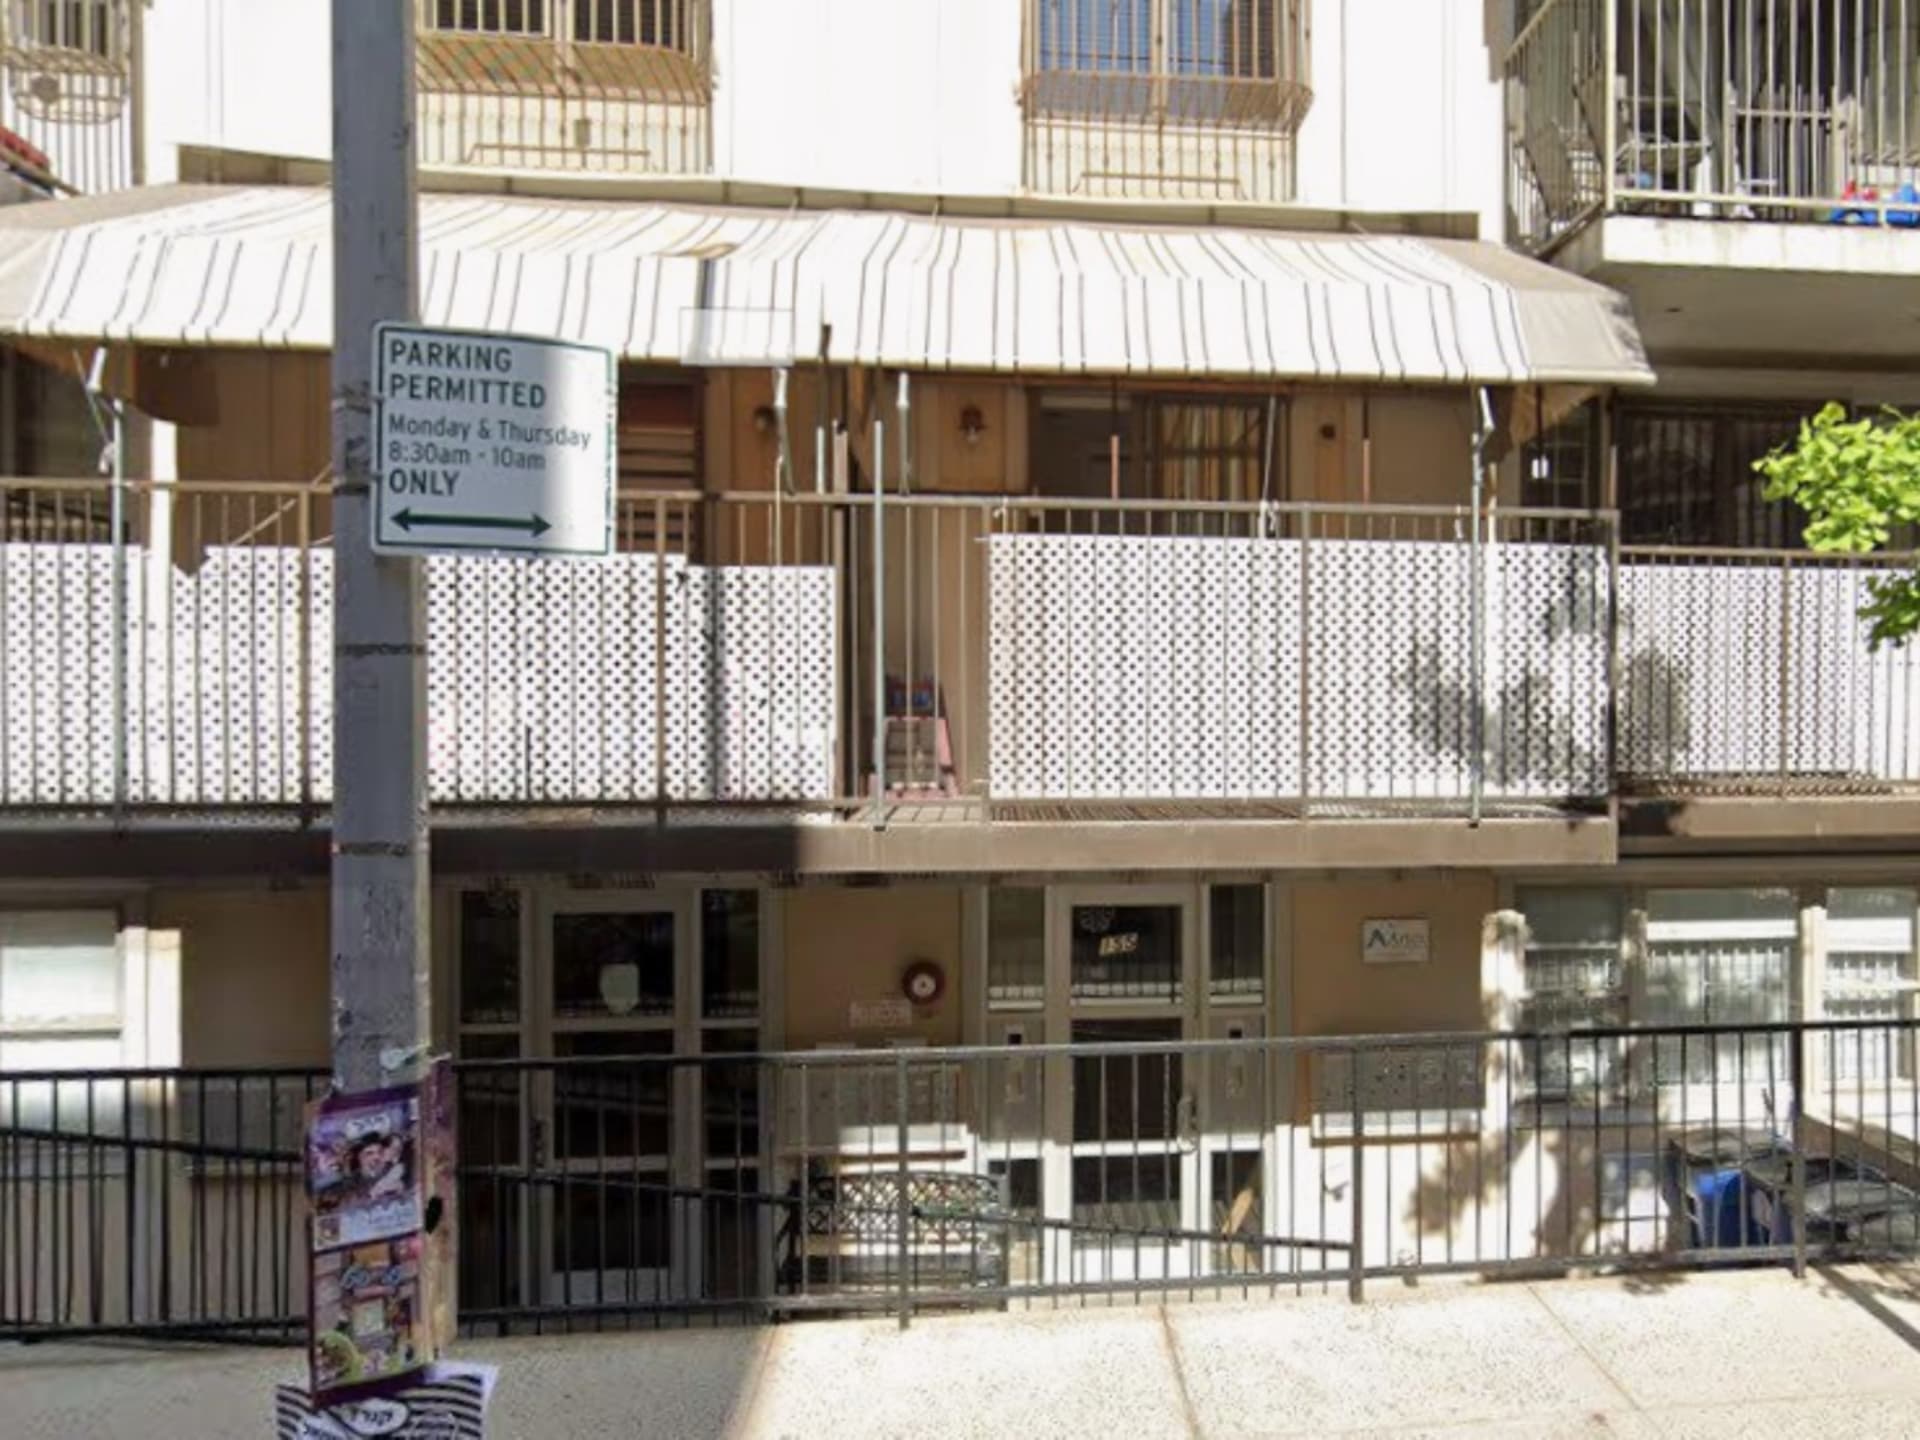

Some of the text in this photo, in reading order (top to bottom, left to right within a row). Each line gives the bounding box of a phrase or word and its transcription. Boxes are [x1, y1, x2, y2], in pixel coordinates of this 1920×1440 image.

[390, 339, 512, 372] PARKING
[390, 374, 546, 408] PERMITTED
[389, 414, 591, 448] Monday & Thursday
[389, 442, 470, 464] 8:30am
[492, 447, 546, 469] 10am
[389, 469, 459, 495] ONLY
